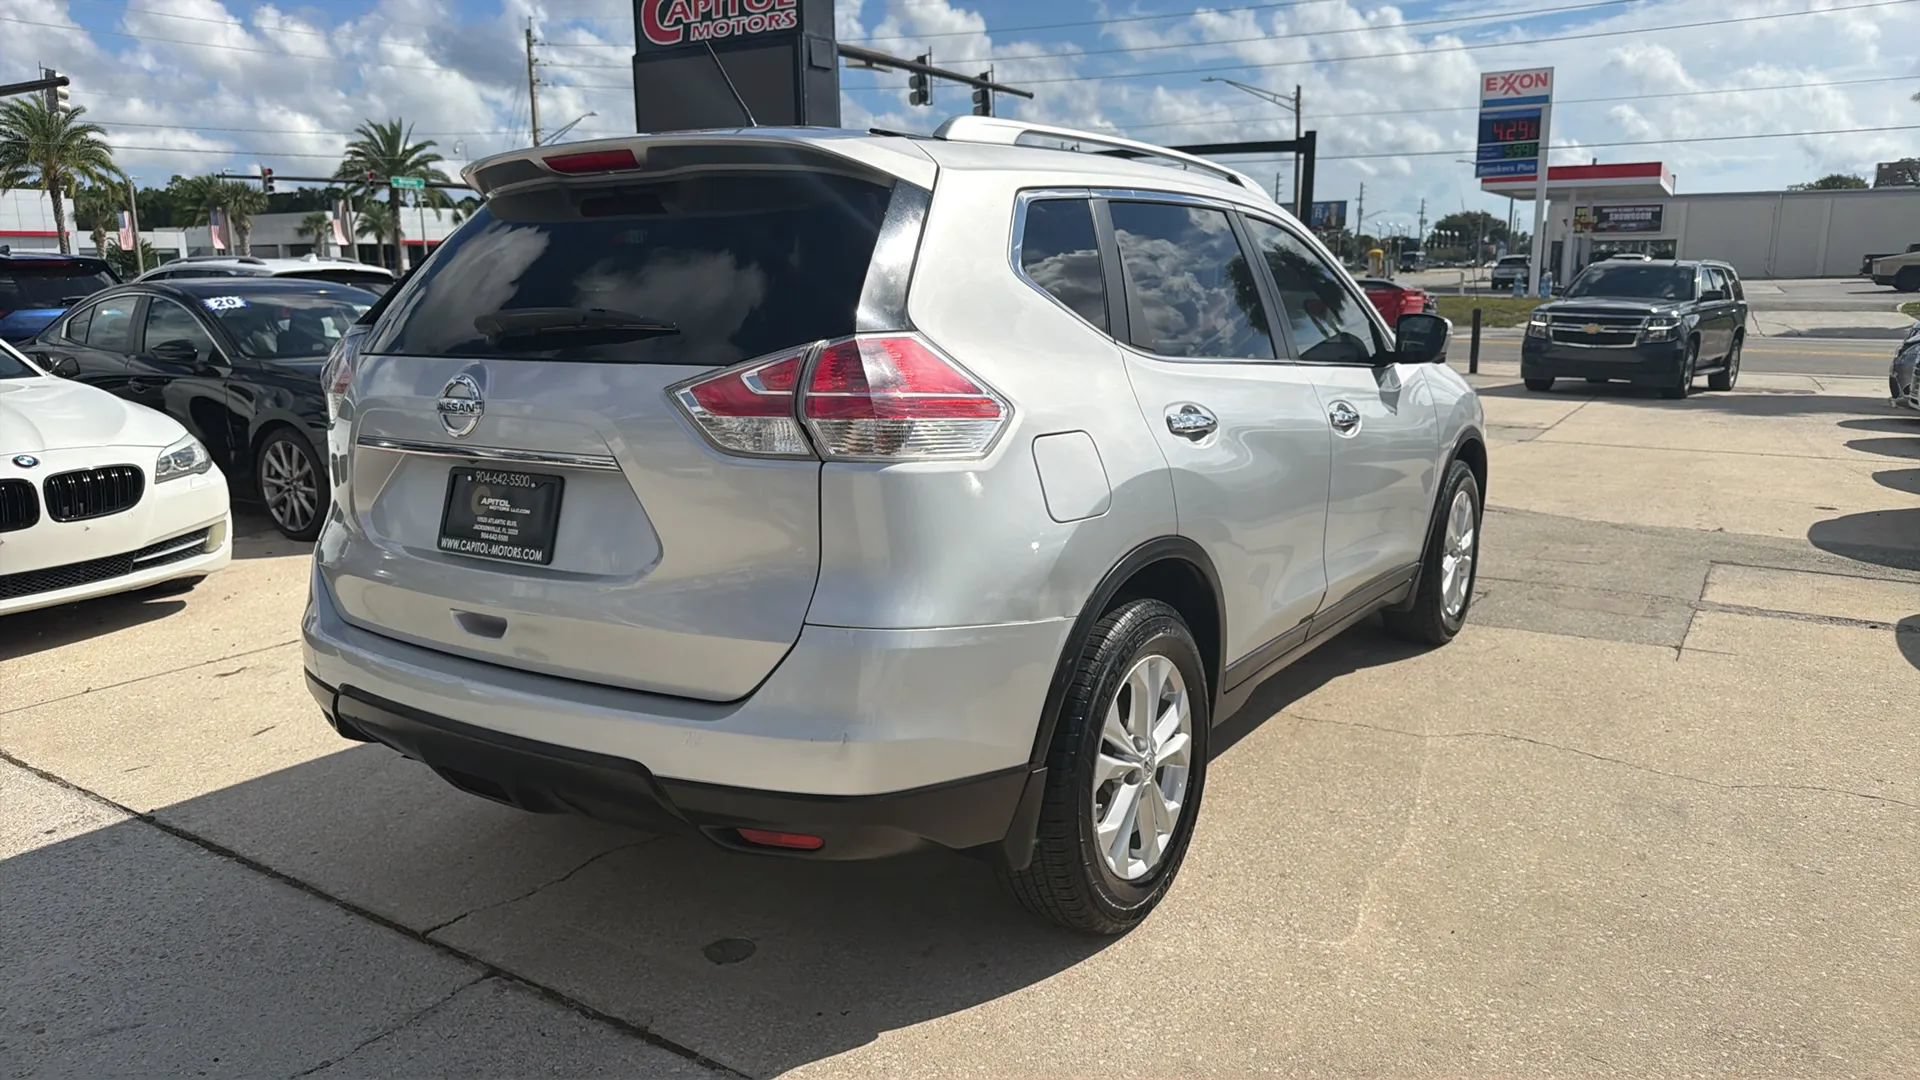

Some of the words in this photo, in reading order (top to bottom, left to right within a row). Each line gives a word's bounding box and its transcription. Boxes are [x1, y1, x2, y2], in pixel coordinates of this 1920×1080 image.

[690, 10, 797, 42] MOTORS
[1485, 72, 1548, 95] EXXON
[214, 298, 236, 307] 20
[437, 402, 475, 412] NISSAN
[475, 471, 530, 488] 904-642-5500
[441, 538, 543, 561] WWW.CAPITOL-MOTORS.COM
